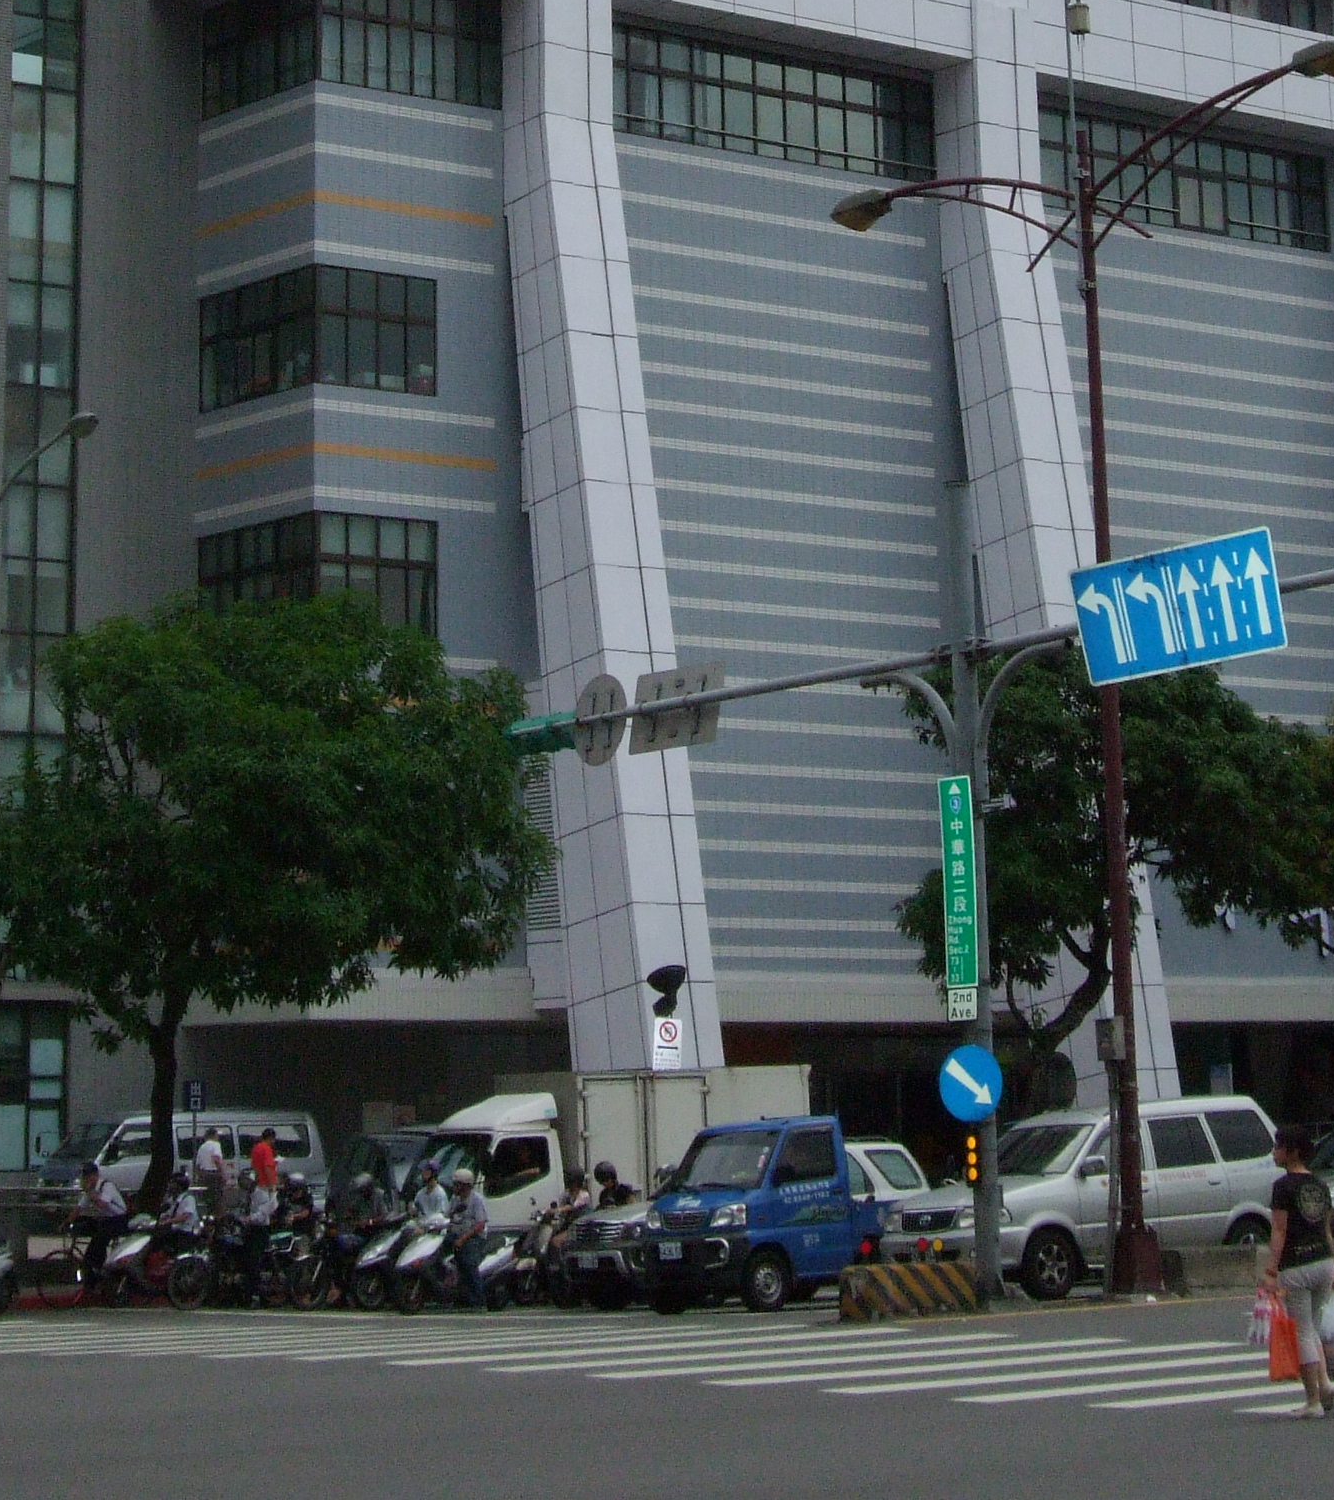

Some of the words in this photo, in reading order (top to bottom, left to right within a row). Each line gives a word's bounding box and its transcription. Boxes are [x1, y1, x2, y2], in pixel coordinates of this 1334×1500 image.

[949, 817, 967, 913] 中華路二段
[947, 914, 973, 926] Zhong
[948, 926, 964, 936] Hua
[952, 991, 973, 1004] 2nd
[950, 1007, 976, 1020] Ave.
[190, 1081, 202, 1110] 出口
